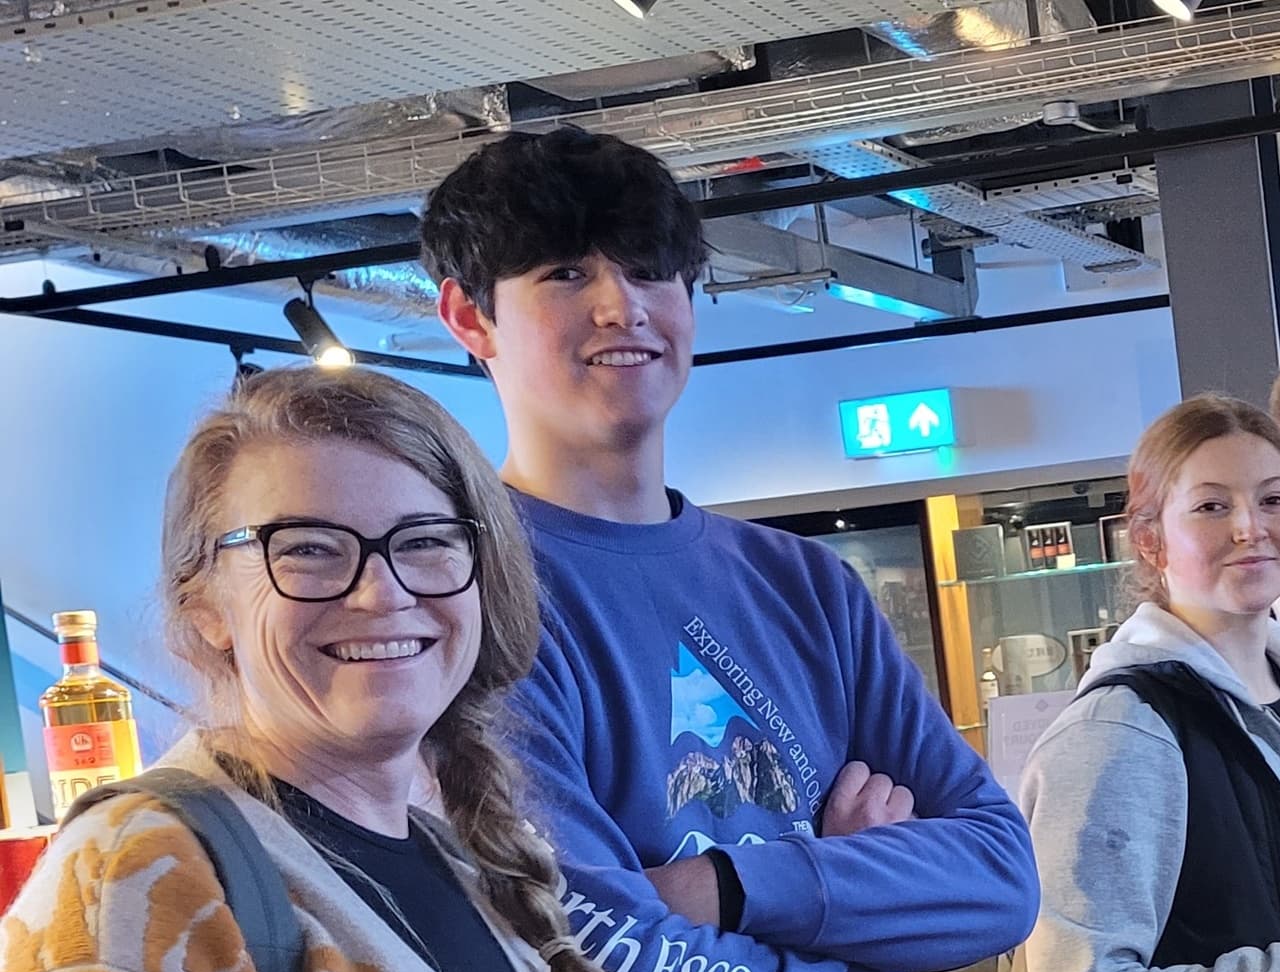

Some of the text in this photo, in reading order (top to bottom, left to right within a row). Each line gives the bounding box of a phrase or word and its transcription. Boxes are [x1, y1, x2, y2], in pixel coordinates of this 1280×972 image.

[683, 615, 764, 707] Exploring
[757, 698, 796, 743] New
[789, 743, 818, 783] and
